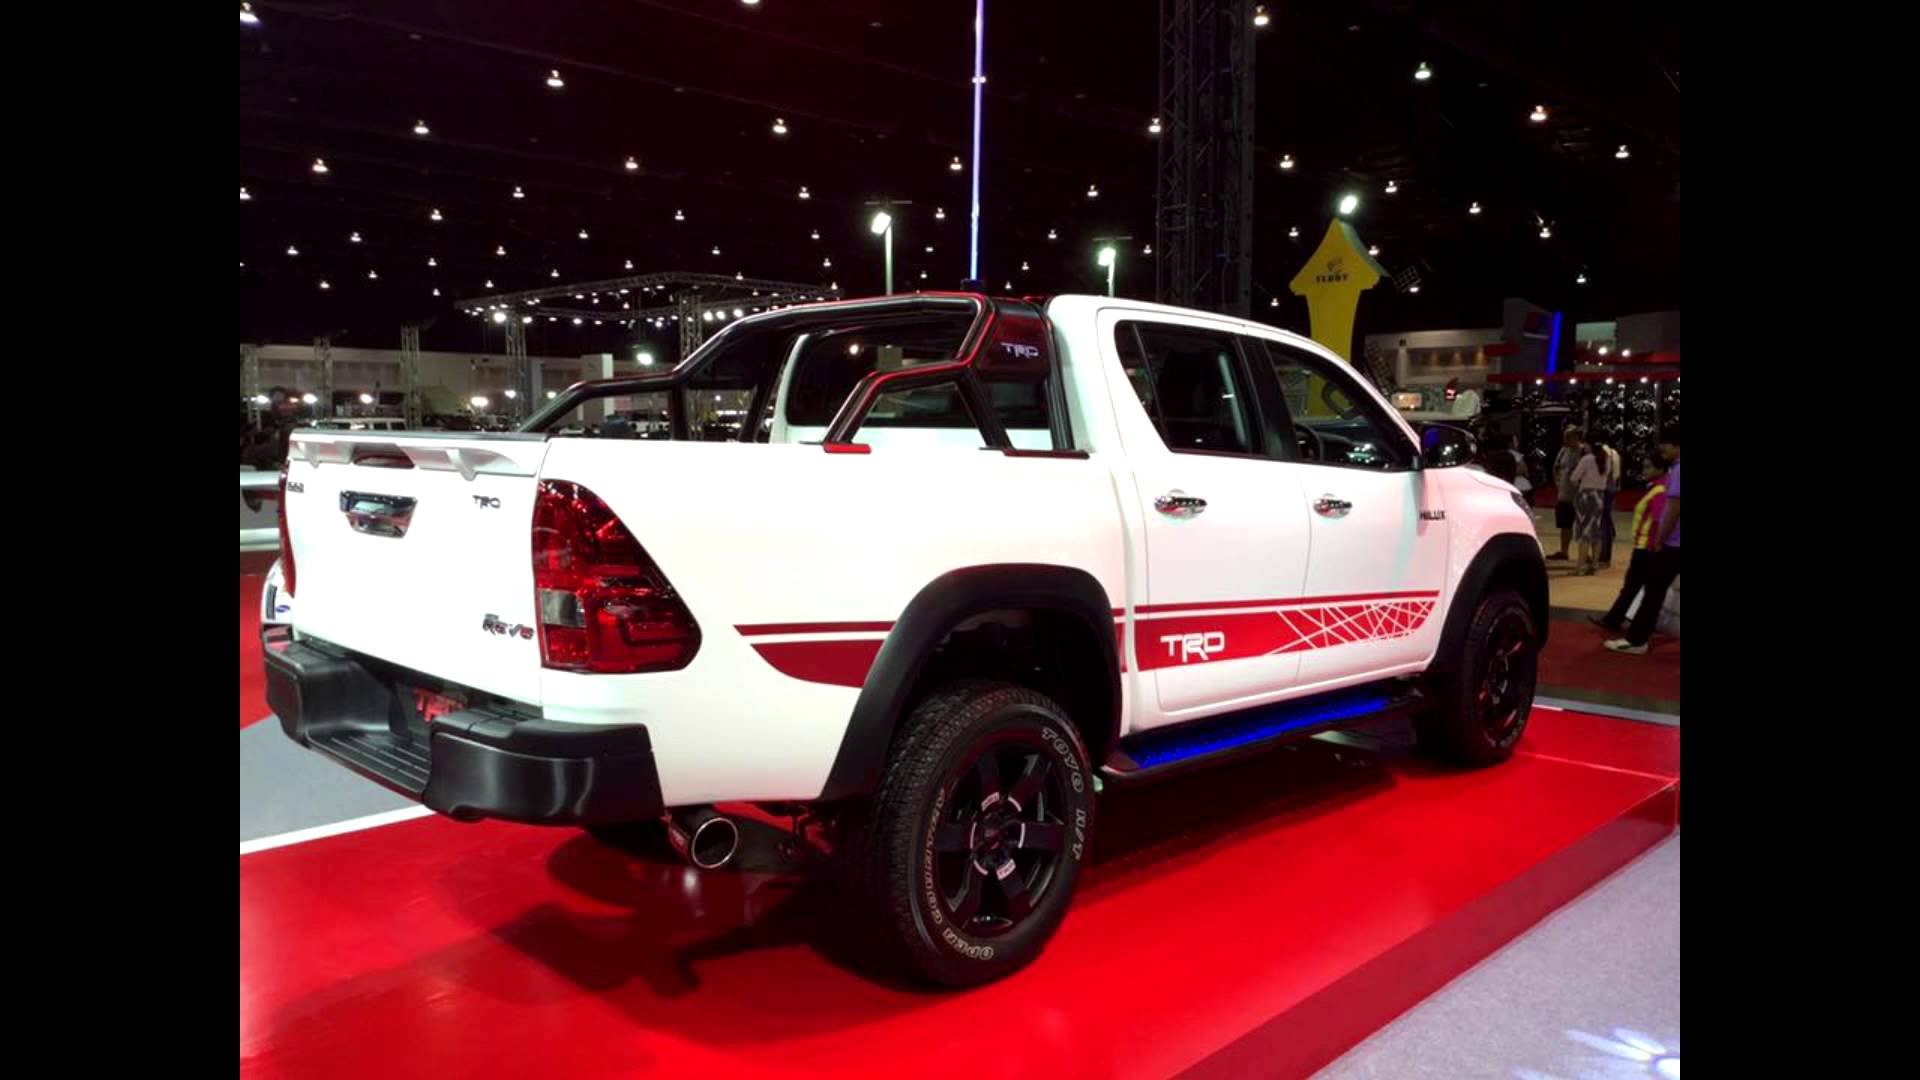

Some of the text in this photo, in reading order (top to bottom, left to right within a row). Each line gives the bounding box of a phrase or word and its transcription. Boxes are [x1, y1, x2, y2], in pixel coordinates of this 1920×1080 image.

[1000, 341, 1039, 359] TRD
[1160, 631, 1225, 663] TRD
[1041, 726, 1084, 793] TOYO
[941, 926, 995, 961] OPEN
